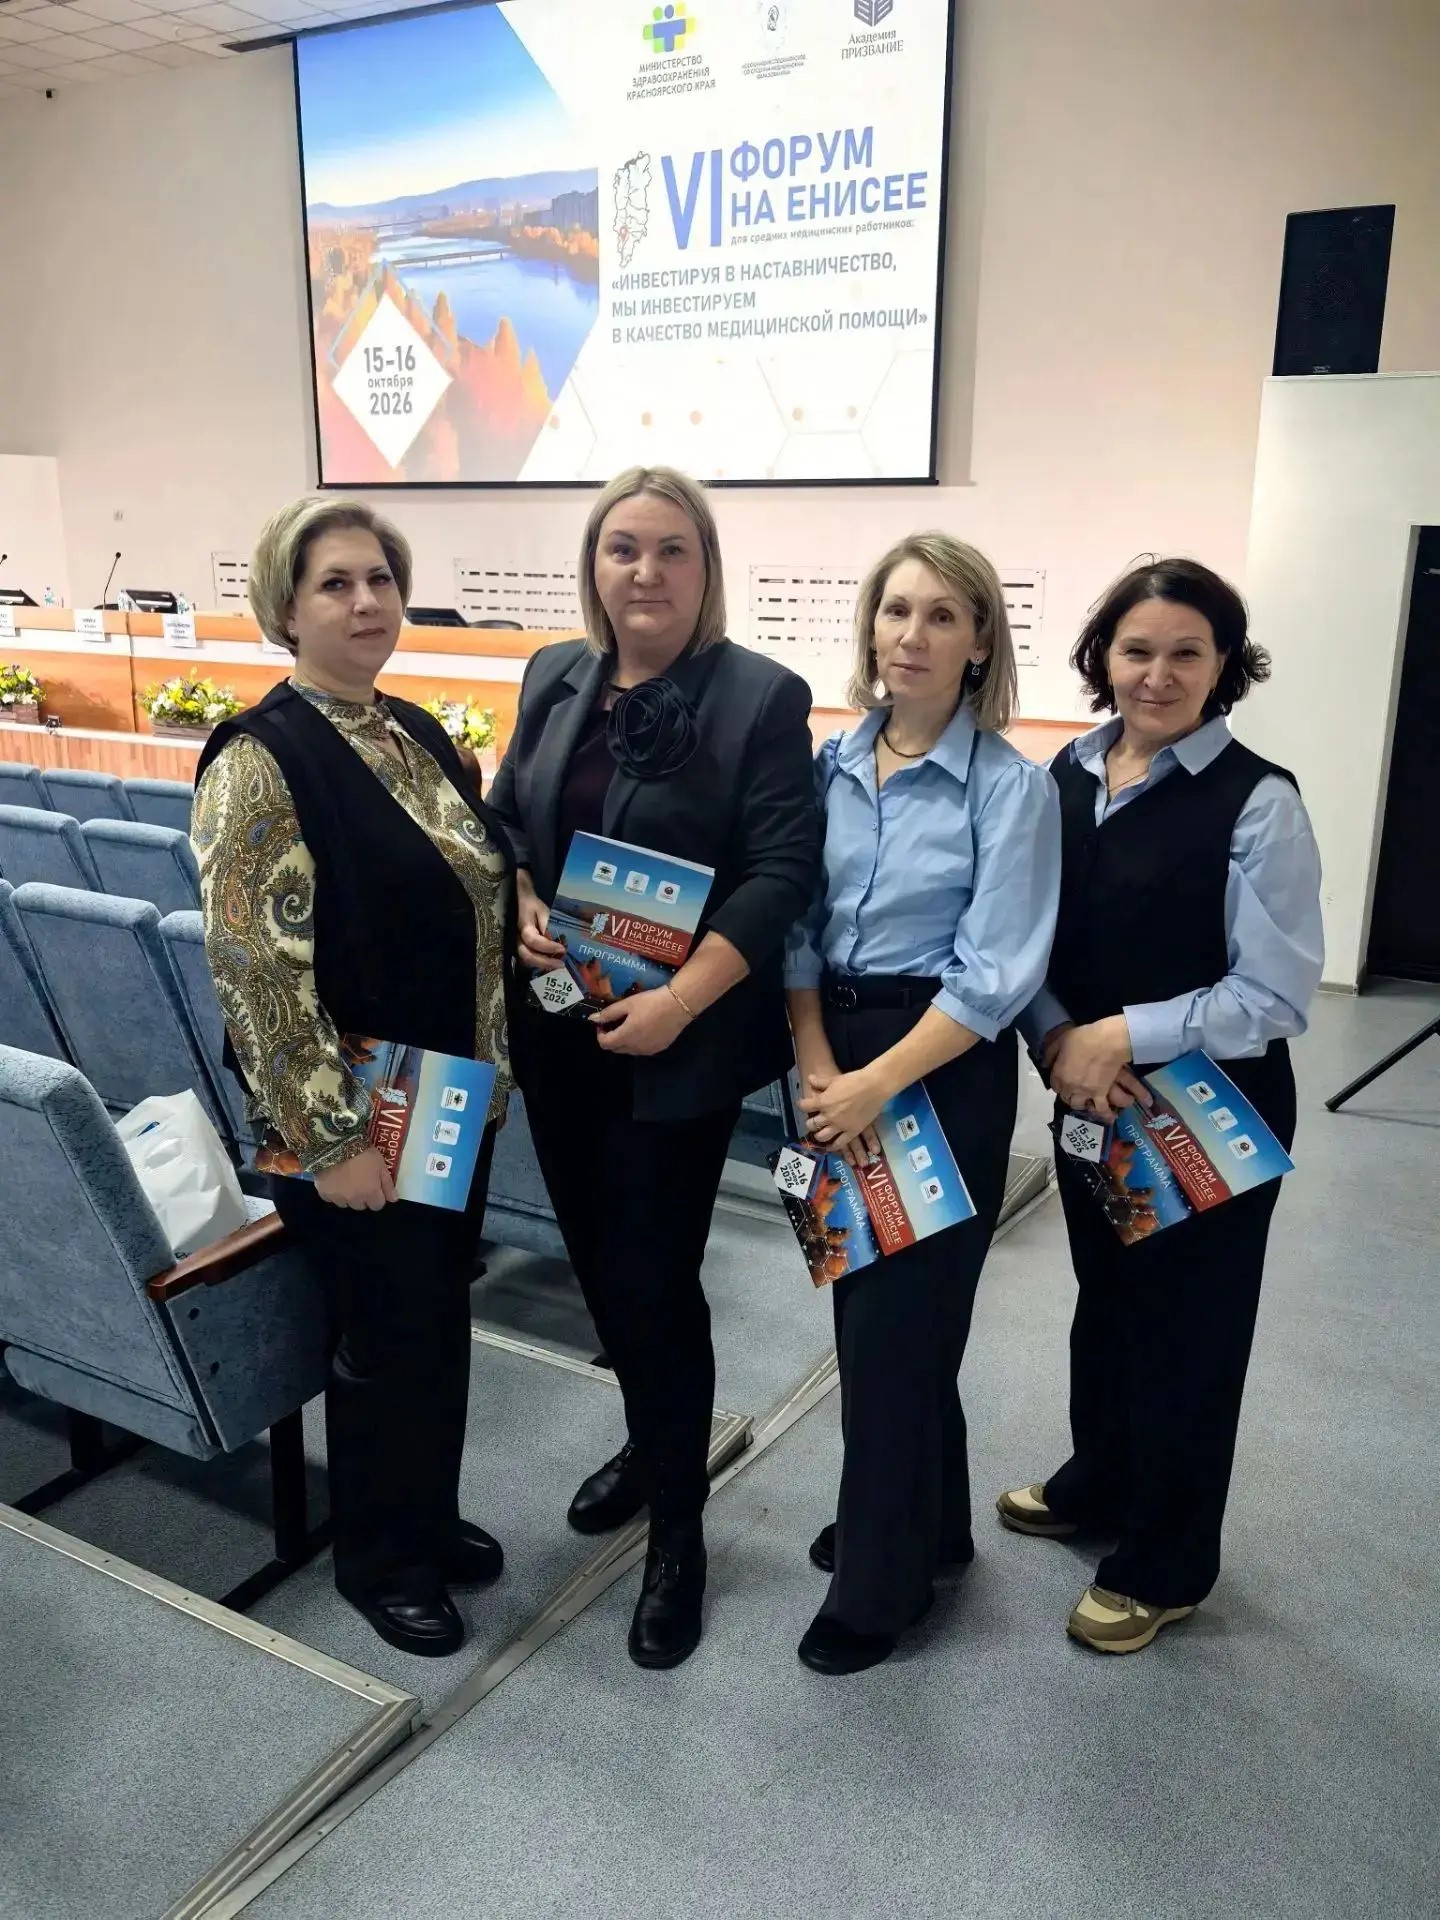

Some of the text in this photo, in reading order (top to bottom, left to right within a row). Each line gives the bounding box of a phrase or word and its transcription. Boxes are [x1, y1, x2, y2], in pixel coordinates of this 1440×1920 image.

[841, 39, 904, 60] ПРИЗВАНИЕ
[848, 29, 897, 45] Академия
[639, 54, 703, 73] МИНИСТЕРСТВО
[626, 79, 716, 101] КРАСНОЯРСКОГО КРАЯ
[632, 66, 710, 88] ЗДРАВООХРАНЕНИЯ
[730, 126, 874, 182] ФОРУМ
[661, 149, 723, 250] VI
[731, 171, 928, 227] НА ЕНИСЕЕ
[611, 252, 897, 291] «ИНВЕСТИРУЯ В НАСТАВНИЧЕСТВО,
[612, 292, 756, 318] МЫ ИНВЕСТИРУЕМ
[612, 307, 928, 344] В КАЧЕСТВО МЕДИЦИНСКОЙ ПОМОЩИ»
[364, 345, 416, 373] 15-16
[368, 374, 414, 390] октября
[370, 392, 413, 415] 2026
[611, 915, 630, 939] VI
[632, 921, 673, 940] ФОРУМ
[629, 930, 642, 940] НА
[645, 935, 685, 952] ЕНИСЕЕ
[578, 944, 647, 972] ПРОГРАММА
[546, 976, 573, 992] 15-16
[543, 991, 566, 1005] 2026
[1066, 1131, 1085, 1153] 2026
[1077, 1123, 1099, 1149] 15-16
[1165, 1125, 1191, 1150] VI
[1125, 1124, 1171, 1189] ПРОГРАММА
[1187, 1144, 1217, 1183] ФОРУМ
[780, 1165, 795, 1189] 2026
[792, 1157, 808, 1185] 15-16
[867, 1163, 889, 1190] VI
[1178, 1148, 1217, 1201] НА ЕНИСЕЕ
[834, 1160, 866, 1230] ПРОГРАММА
[884, 1184, 905, 1226] ФОРУМ
[876, 1188, 902, 1244] НА ЕНИСЕЕ
